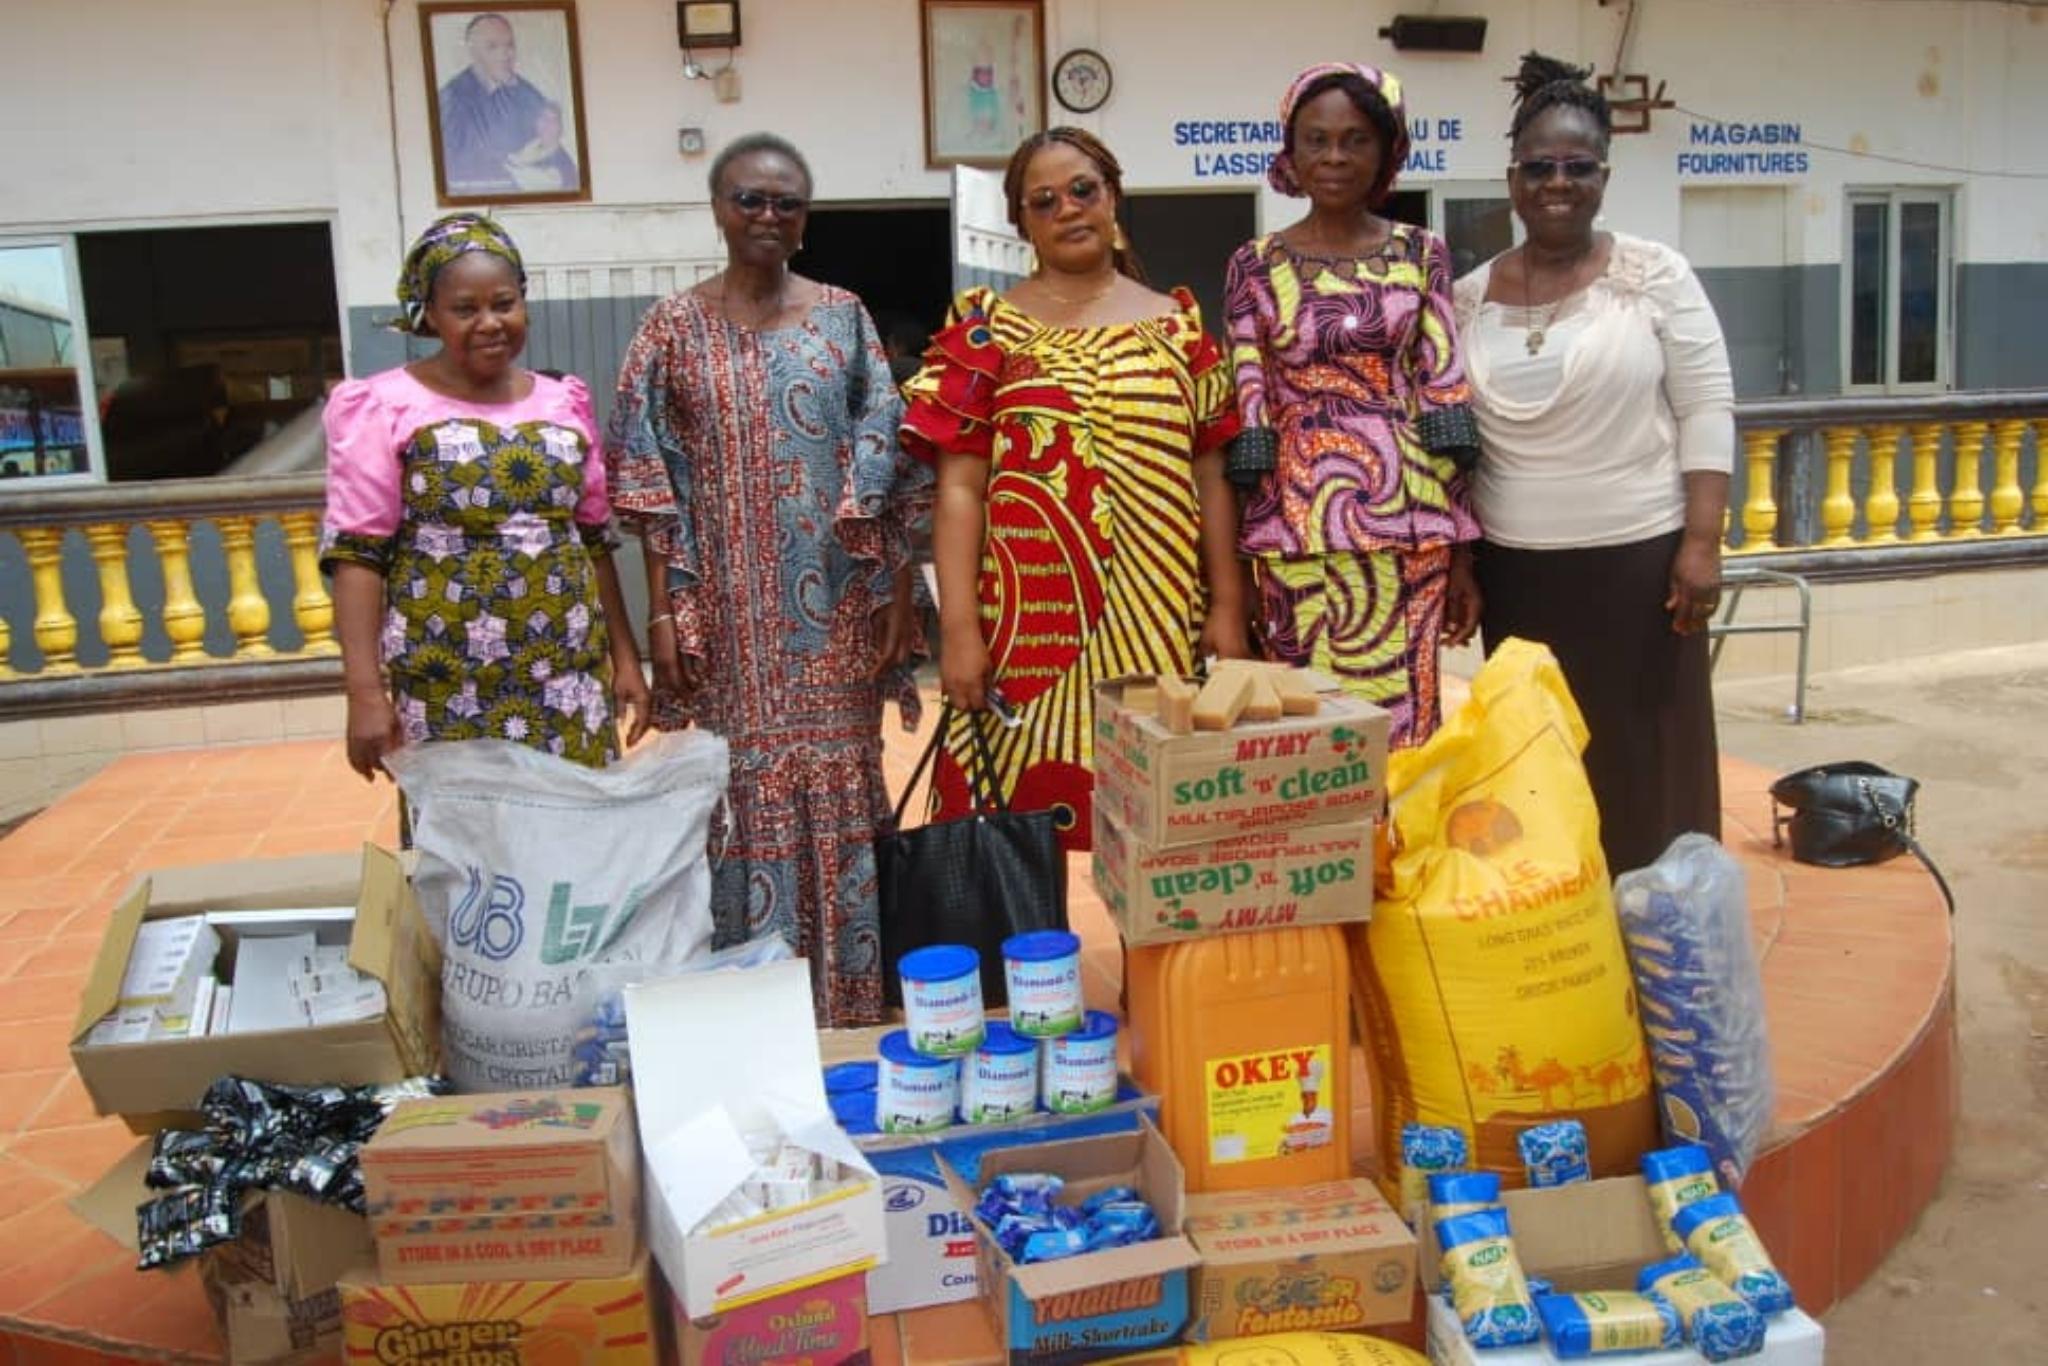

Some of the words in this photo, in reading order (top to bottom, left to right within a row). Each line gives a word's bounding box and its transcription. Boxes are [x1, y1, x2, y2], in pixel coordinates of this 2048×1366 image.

[1174, 121, 1281, 145] SECRETARI
[1438, 119, 1462, 140] DE
[1677, 153, 1809, 174] FOURNITURES
[1235, 732, 1314, 762] MYMY
[1173, 766, 1246, 806] soft
[1277, 761, 1370, 801] clean
[1151, 861, 1253, 899] clean
[1286, 857, 1356, 896] soft
[446, 961, 524, 1009] RUPO
[1214, 1050, 1316, 1090] OKEY
[928, 1210, 977, 1238] Dia
